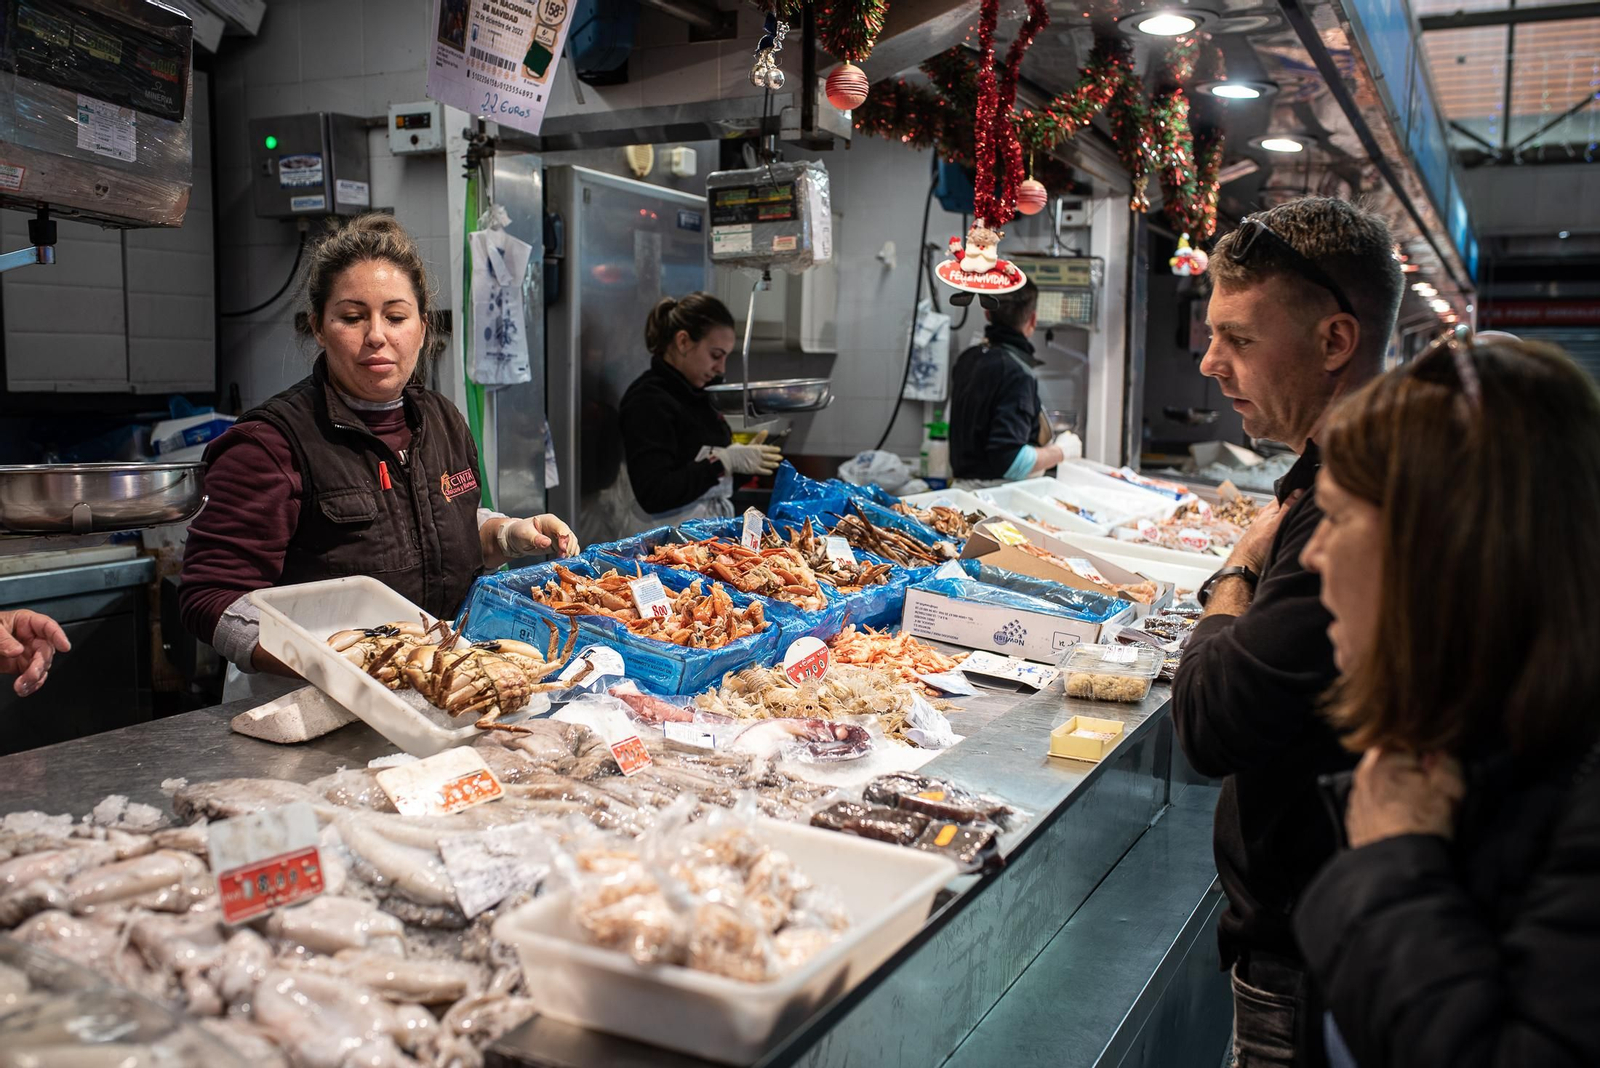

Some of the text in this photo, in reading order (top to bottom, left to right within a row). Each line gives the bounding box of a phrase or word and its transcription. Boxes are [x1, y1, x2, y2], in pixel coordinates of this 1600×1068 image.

[482, 3, 518, 23] DE NAVIDAD
[511, 25, 523, 36] 2022
[481, 92, 498, 114] 22
[450, 471, 473, 486] CINTA
